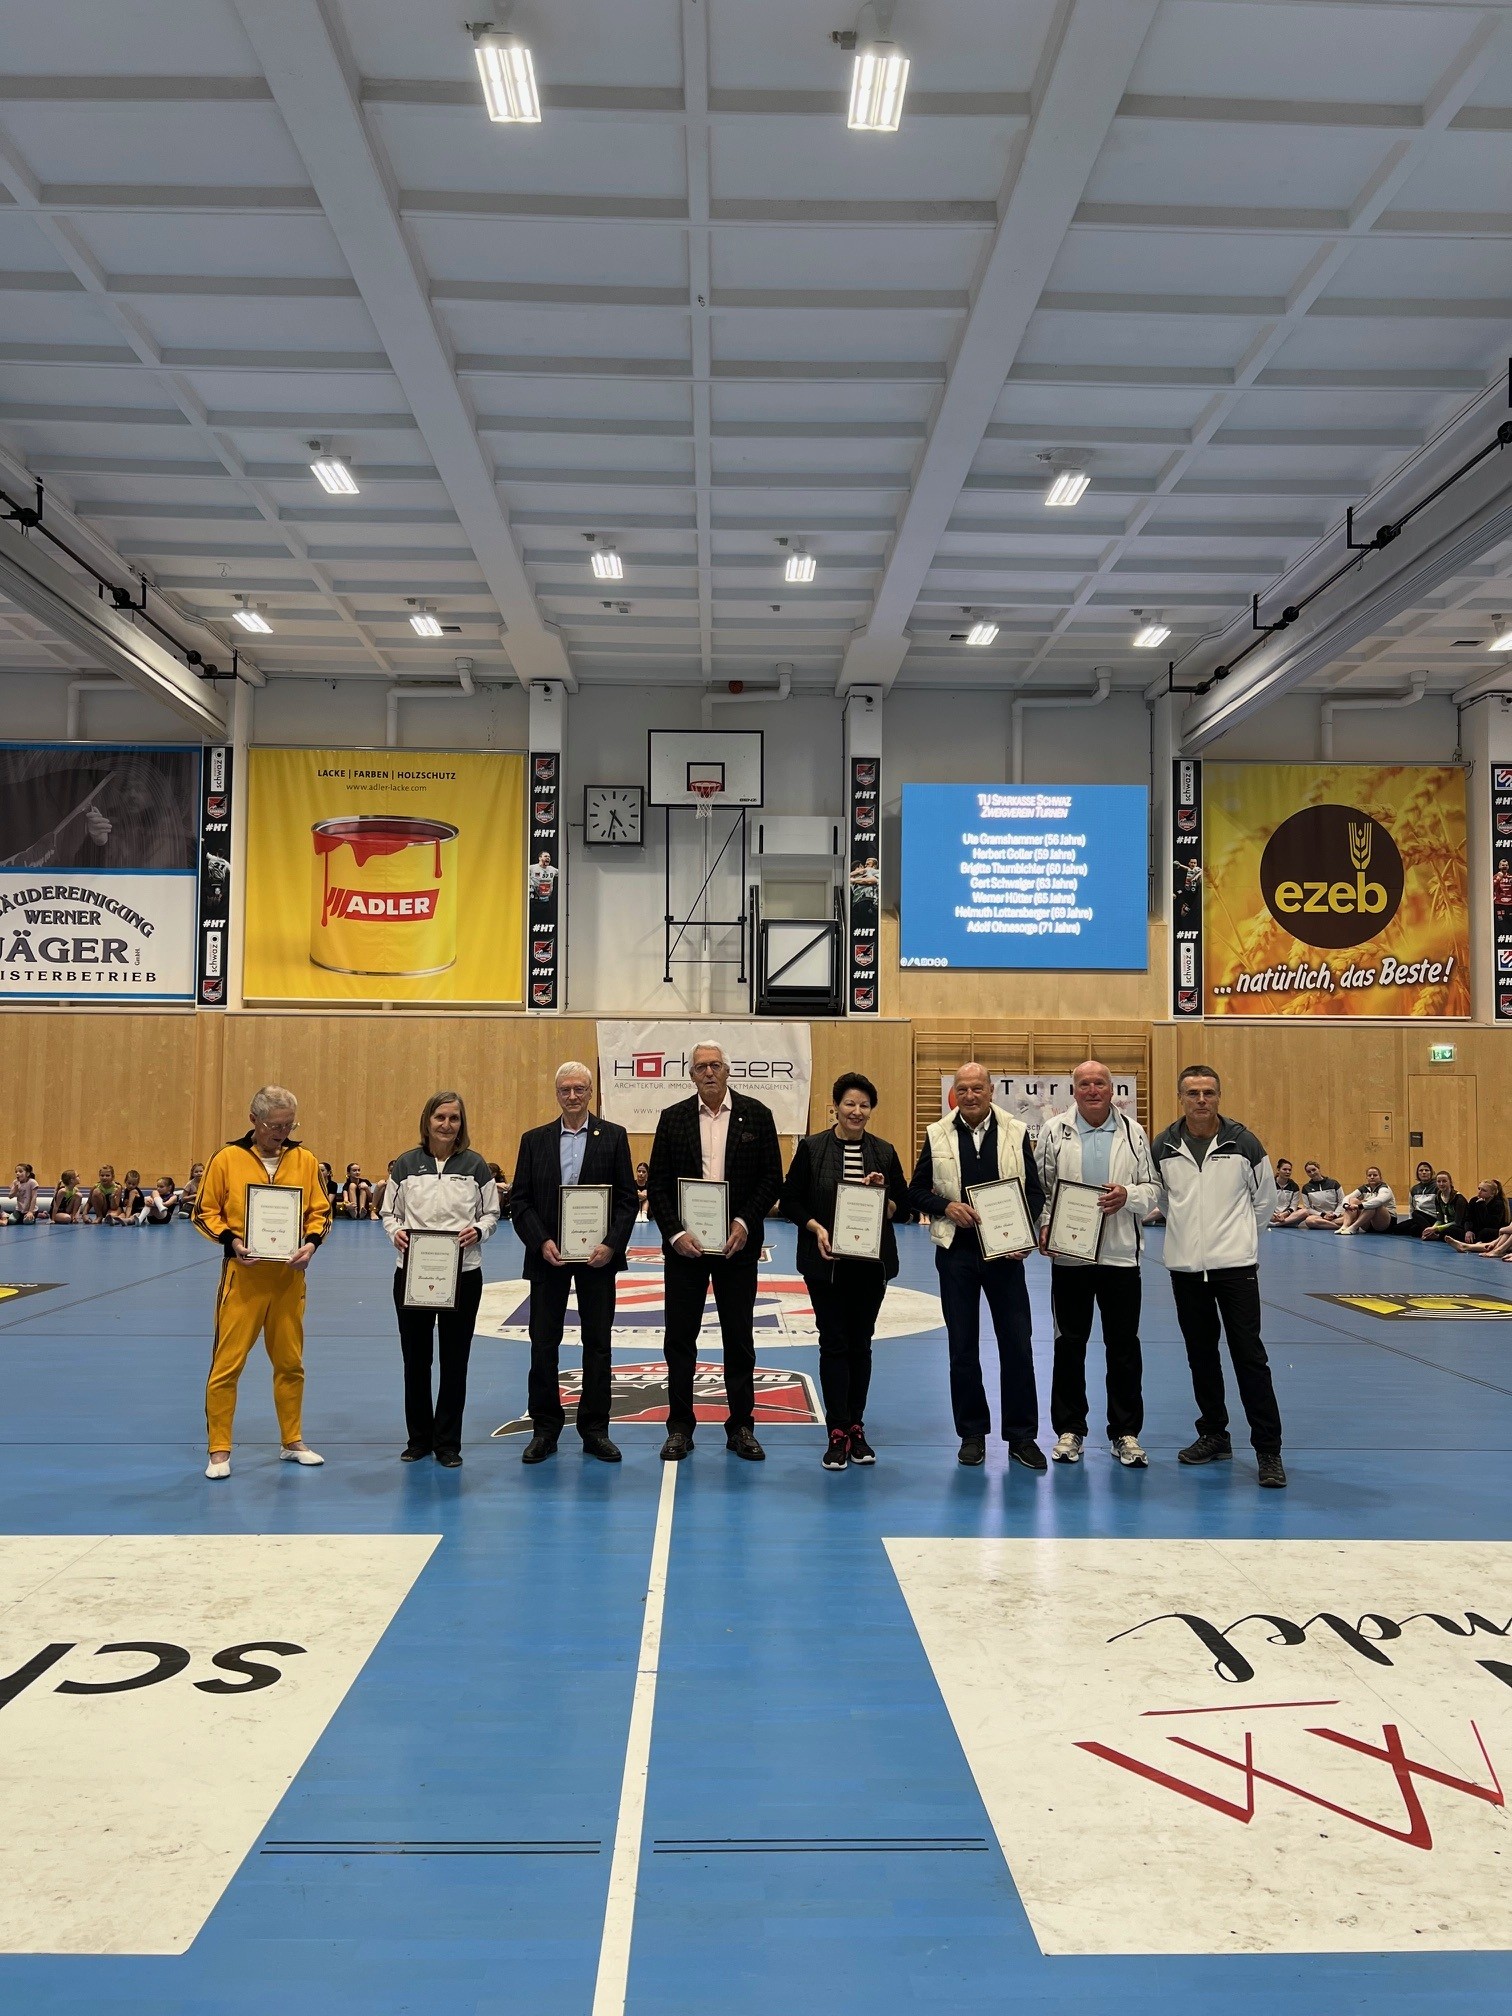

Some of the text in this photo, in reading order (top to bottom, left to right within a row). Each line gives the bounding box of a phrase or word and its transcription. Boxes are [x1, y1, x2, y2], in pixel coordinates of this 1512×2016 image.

[213, 760, 222, 788] schwaz
[317, 769, 346, 778] LACKE
[353, 770, 389, 779] FARBEN
[397, 771, 456, 780] HOLZSCHUTZ
[346, 783, 427, 792] www.adler-lacke.com
[533, 786, 556, 794] #HT
[1183, 773, 1191, 801] schwaz
[855, 791, 876, 799] #HT
[205, 823, 229, 832] #HT
[533, 829, 556, 838] #HT
[854, 833, 876, 842] #HT
[963, 833, 979, 845] Ute
[1060, 834, 1086, 847] Jahre)
[1176, 835, 1198, 844] #HT
[972, 848, 1006, 859] Herbert
[1049, 849, 1076, 862] Jahre)
[961, 862, 991, 875] Brigitte
[1061, 863, 1087, 876] Jahre)
[1051, 878, 1077, 891] Jahre)
[1274, 871, 1388, 914] ezeb
[972, 892, 1005, 903] Werner
[1049, 893, 1076, 906] Jahre)
[346, 895, 431, 916] ADLER
[0, 886, 155, 938] ÄUDEREINIGUNG
[24, 909, 102, 926] WERNER
[955, 906, 993, 918] Helmuth
[1067, 907, 1093, 920] Jahre)
[203, 919, 227, 928] #HT
[532, 924, 555, 933] #HT
[967, 921, 991, 933] Adolf
[991, 921, 1038, 935] Ohnesorge
[1054, 922, 1081, 935] Jahre)
[853, 928, 875, 937] #HT
[1176, 931, 1198, 940] #HT
[1497, 934, 1512, 943] #H
[210, 943, 218, 973] schwaz
[532, 968, 555, 976] #HT
[1184, 953, 1192, 983] schwaz
[0, 970, 157, 982] ISTERBETRIEB
[853, 971, 875, 980] #HT
[1236, 963, 1335, 993] natürlich,
[1340, 964, 1376, 988] das
[1379, 957, 1454, 986] Beste!
[1498, 977, 1512, 986] #H
[614, 1082, 666, 1090] ARCHITEKTUR.
